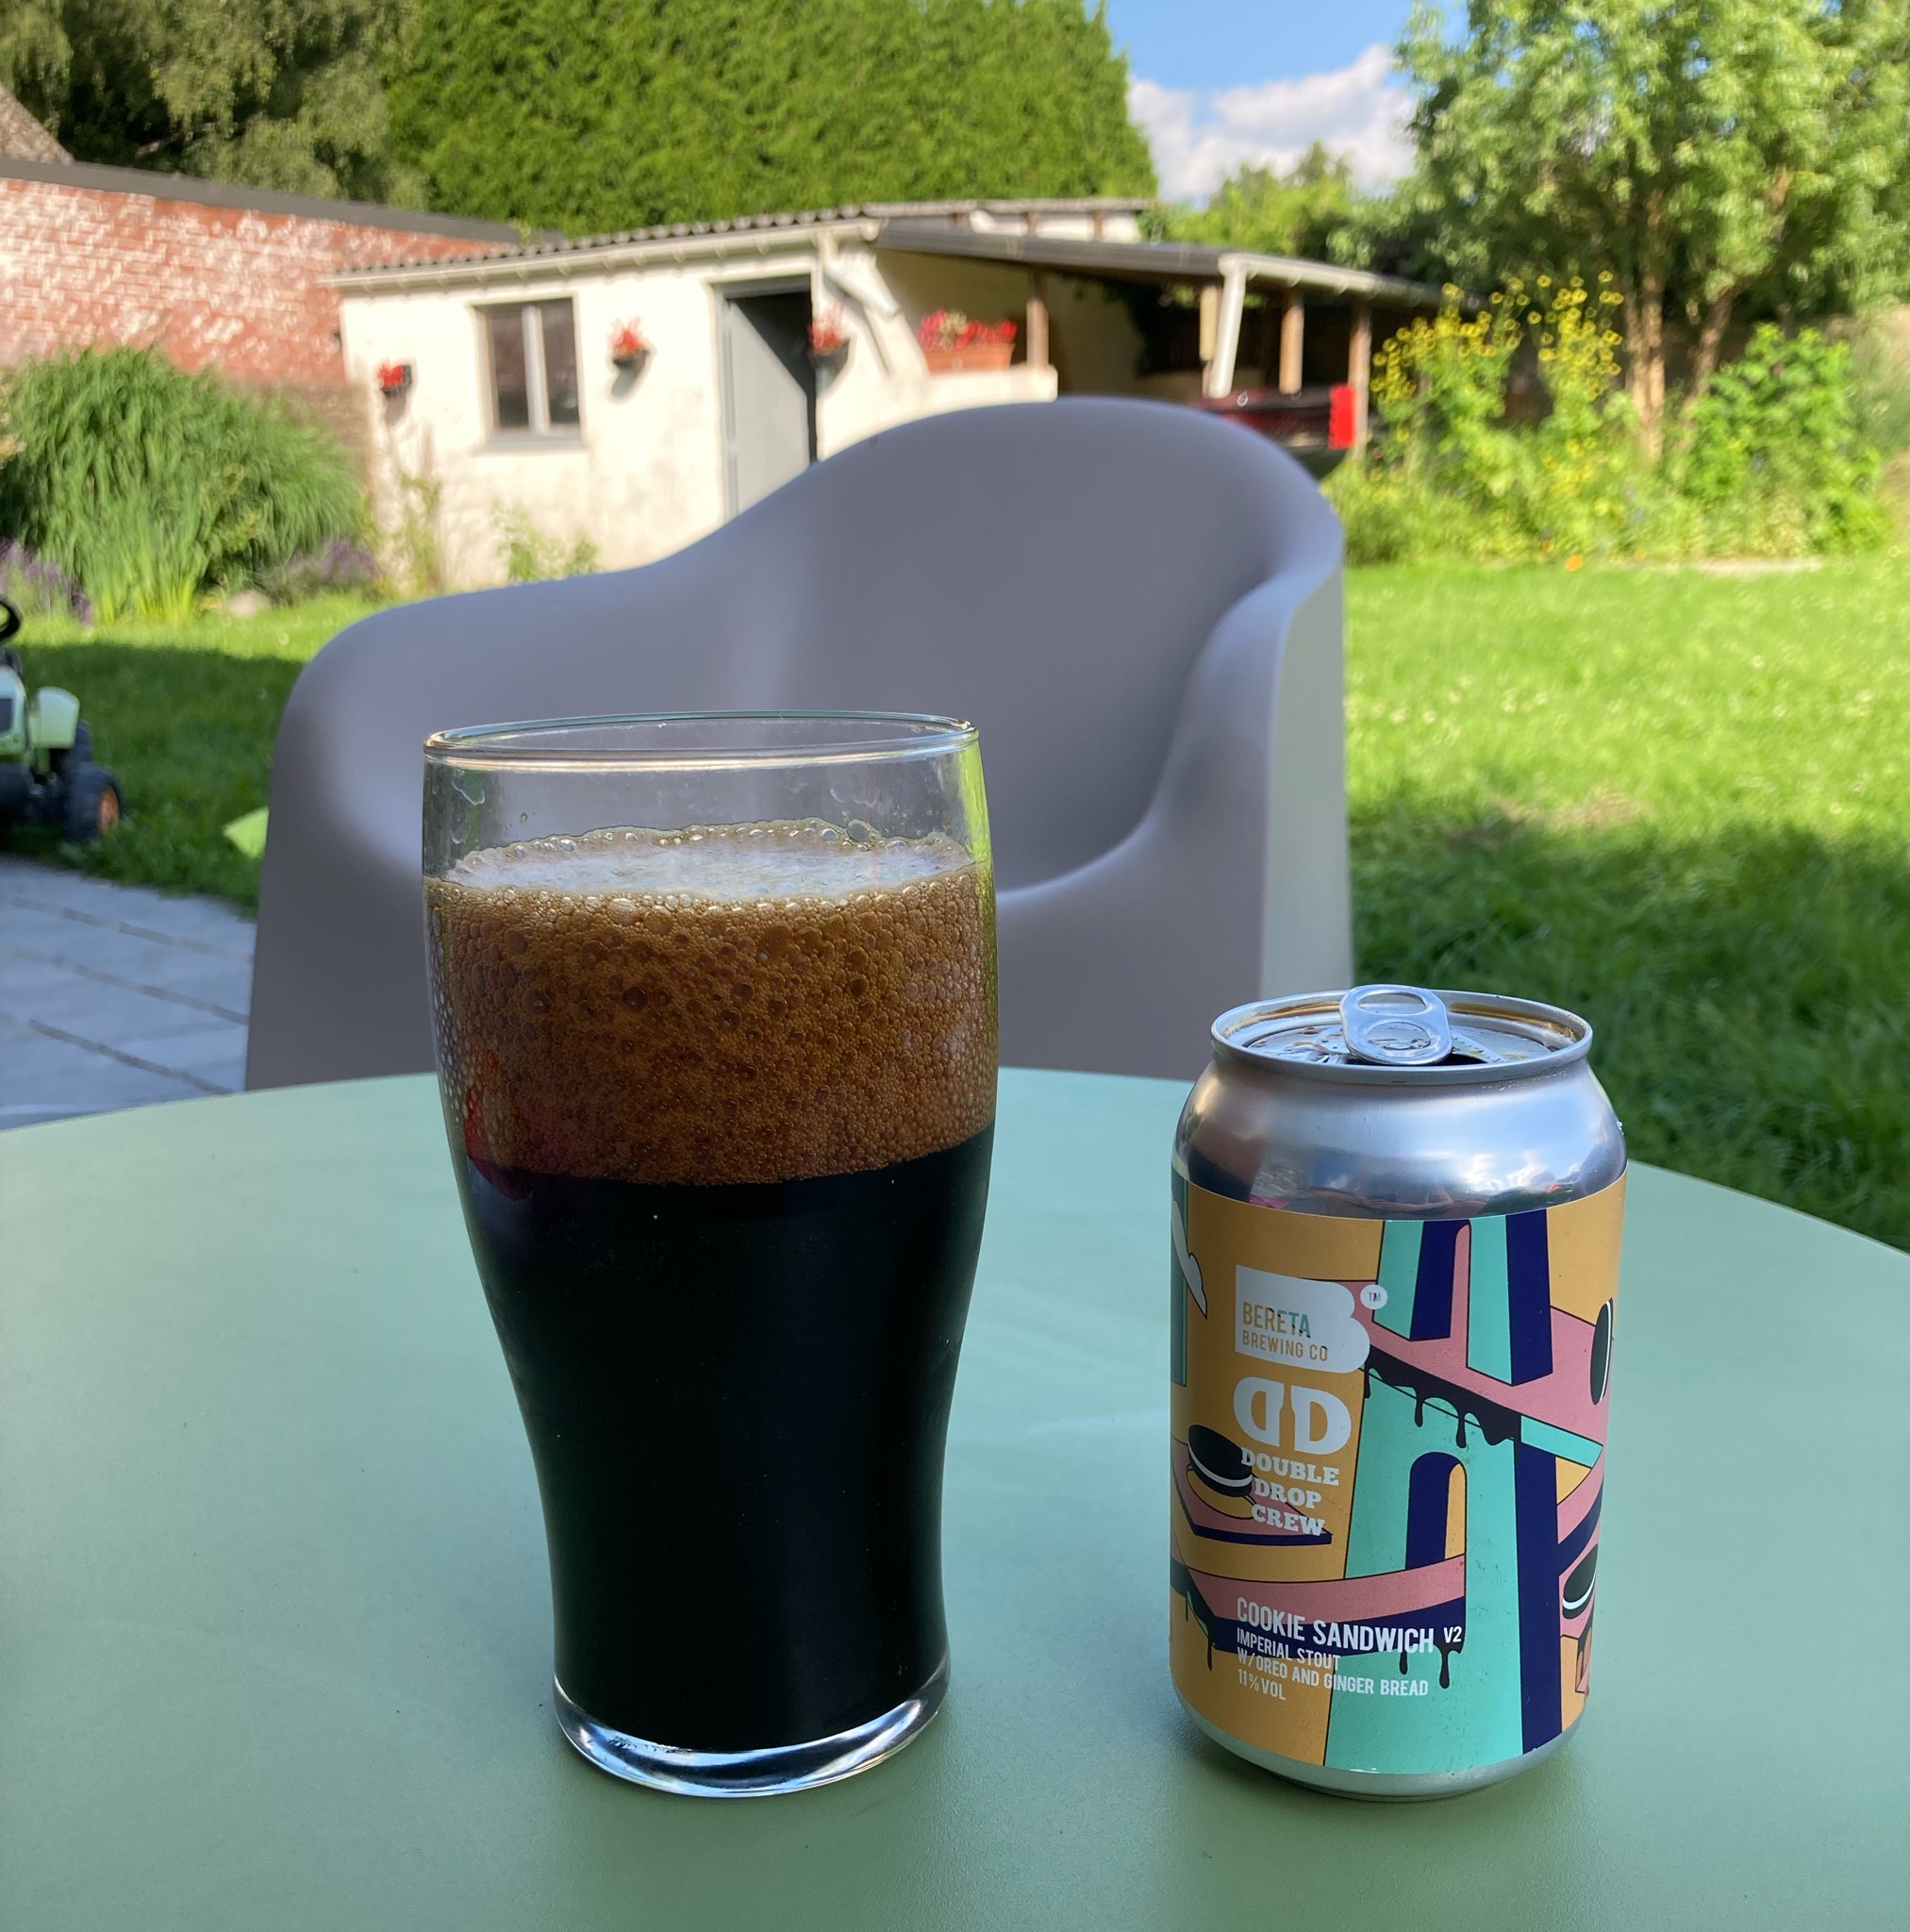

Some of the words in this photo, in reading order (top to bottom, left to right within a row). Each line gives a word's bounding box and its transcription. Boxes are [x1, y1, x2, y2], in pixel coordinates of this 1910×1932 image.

[1242, 1301, 1311, 1339] BERETA
[1242, 1329, 1304, 1358] BREWING
[1309, 1343, 1328, 1361] CO
[1240, 1446, 1339, 1486] DOUBLE
[1254, 1478, 1321, 1508] DROP
[1251, 1504, 1325, 1537] CREW
[1237, 1596, 1305, 1641] COOKIE
[1312, 1619, 1434, 1654] SANDWICH
[1443, 1625, 1462, 1643] V2
[1237, 1627, 1292, 1661] IMPERIAL
[1297, 1648, 1341, 1671] STOUT
[1237, 1646, 1287, 1679] W/OREO
[1291, 1666, 1319, 1687] AND
[1323, 1674, 1374, 1694] GINGER
[1380, 1679, 1429, 1696] BREAD
